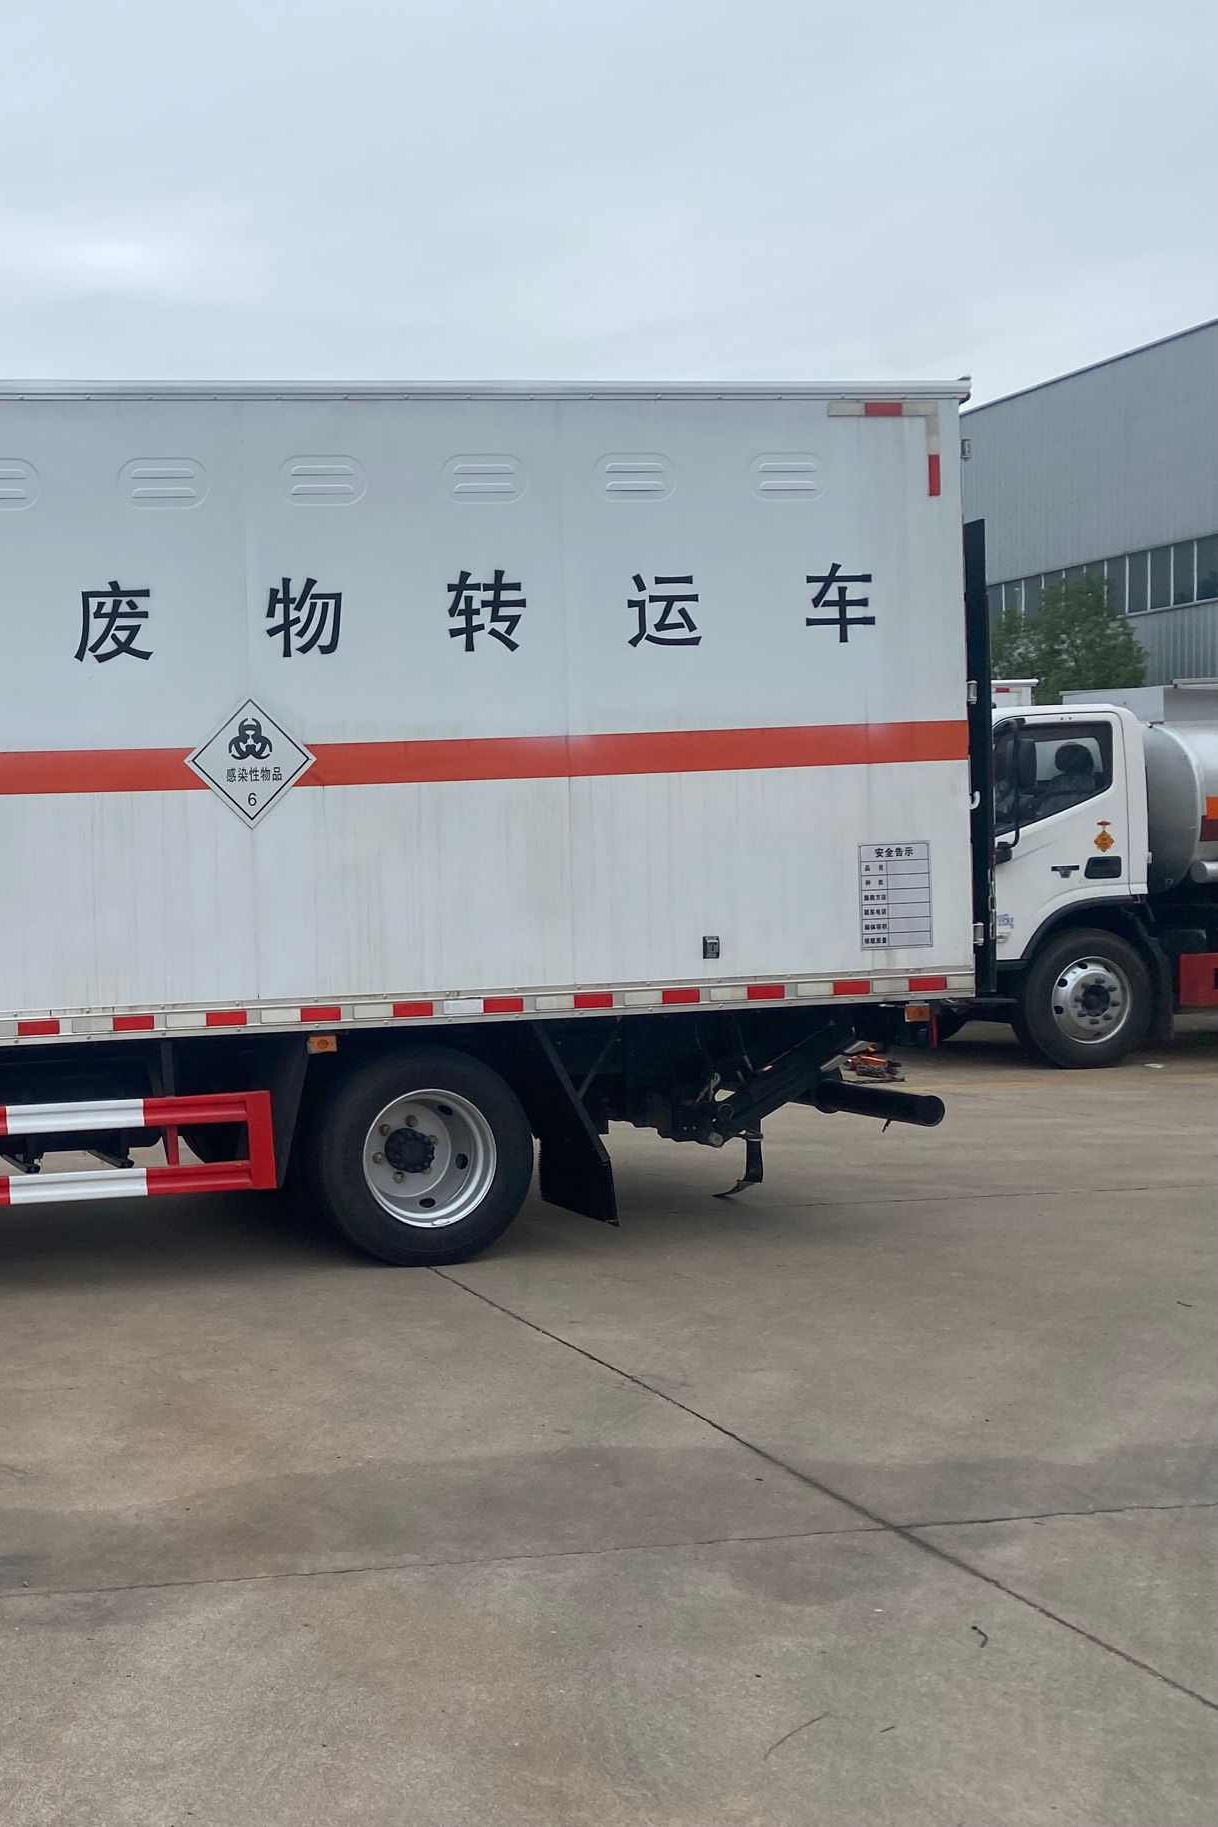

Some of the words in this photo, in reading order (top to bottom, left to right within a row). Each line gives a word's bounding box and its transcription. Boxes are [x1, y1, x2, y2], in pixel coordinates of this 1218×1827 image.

[226, 766, 282, 783] 感染性物品
[248, 792, 257, 806] 6
[874, 846, 914, 858] 安全告示
